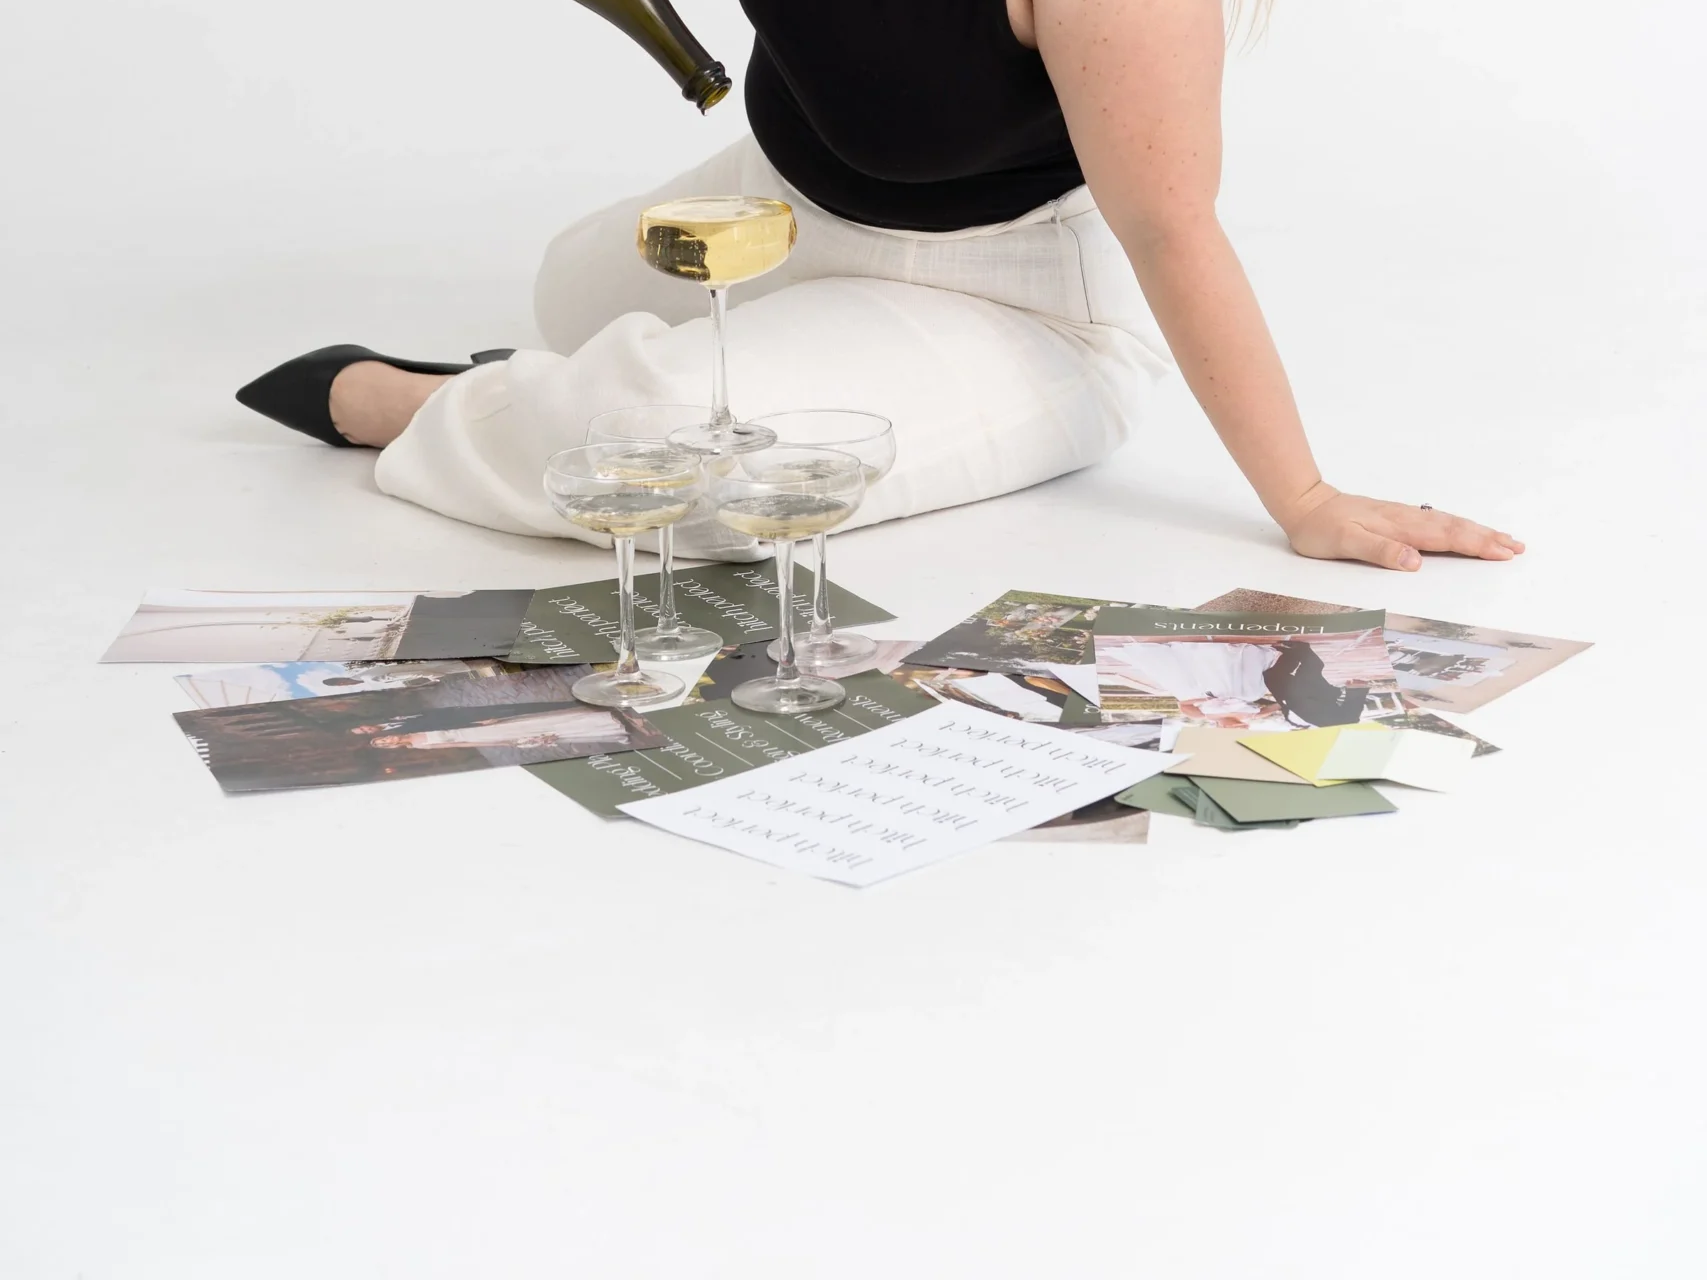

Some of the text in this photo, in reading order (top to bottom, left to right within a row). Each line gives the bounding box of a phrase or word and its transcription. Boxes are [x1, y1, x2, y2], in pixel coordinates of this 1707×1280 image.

[547, 595, 620, 628] perfect
[673, 578, 745, 610] perfect
[721, 607, 774, 635] hitch
[1153, 622, 1325, 635] Elopements
[530, 633, 581, 660] hitch
[695, 709, 754, 741] Styling
[660, 735, 724, 777] Coordi
[741, 739, 770, 749] &
[938, 720, 1127, 775] hitch perfect
[840, 754, 1030, 813] hitch perfect
[890, 737, 1078, 794] hitch perfect
[736, 789, 926, 851] hitch perfect
[788, 772, 978, 832] hitch perfect
[682, 805, 874, 870] hitch perfect
